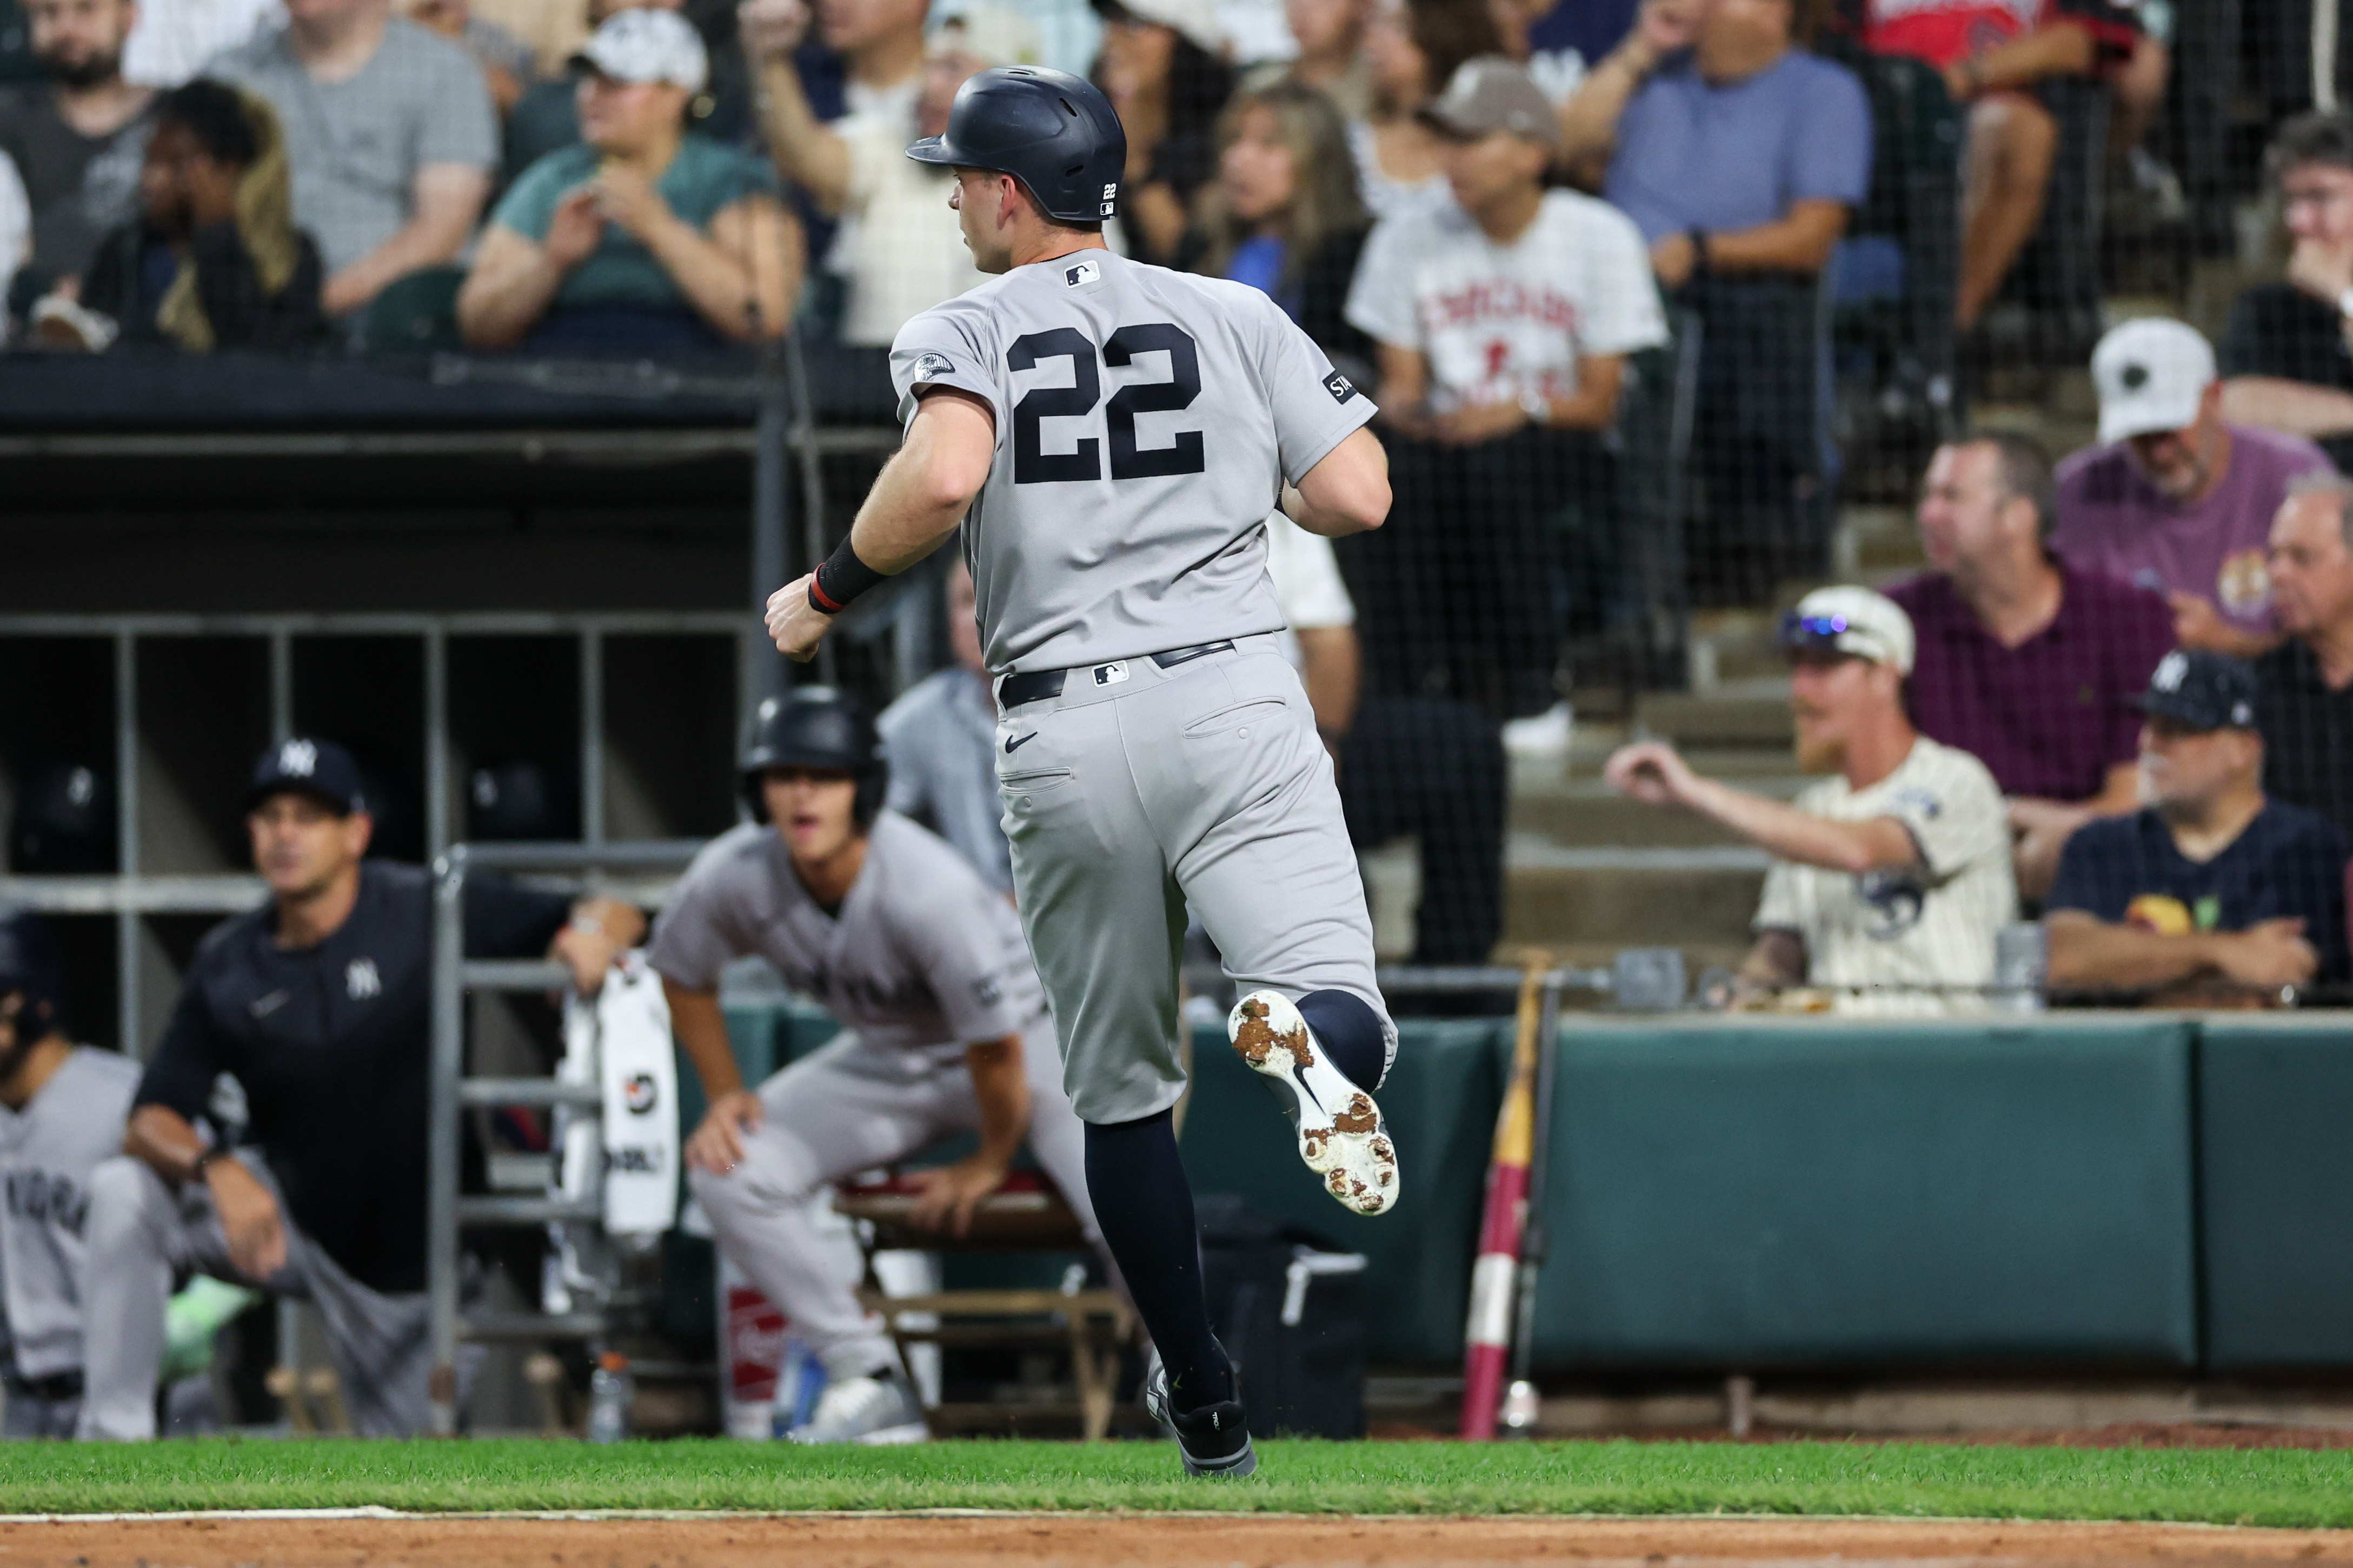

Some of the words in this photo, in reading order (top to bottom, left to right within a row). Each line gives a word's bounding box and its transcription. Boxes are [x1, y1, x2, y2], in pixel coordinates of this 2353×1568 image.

[1103, 183, 1116, 200] 22
[1330, 375, 1352, 397] STA
[1006, 323, 1205, 484] 22
